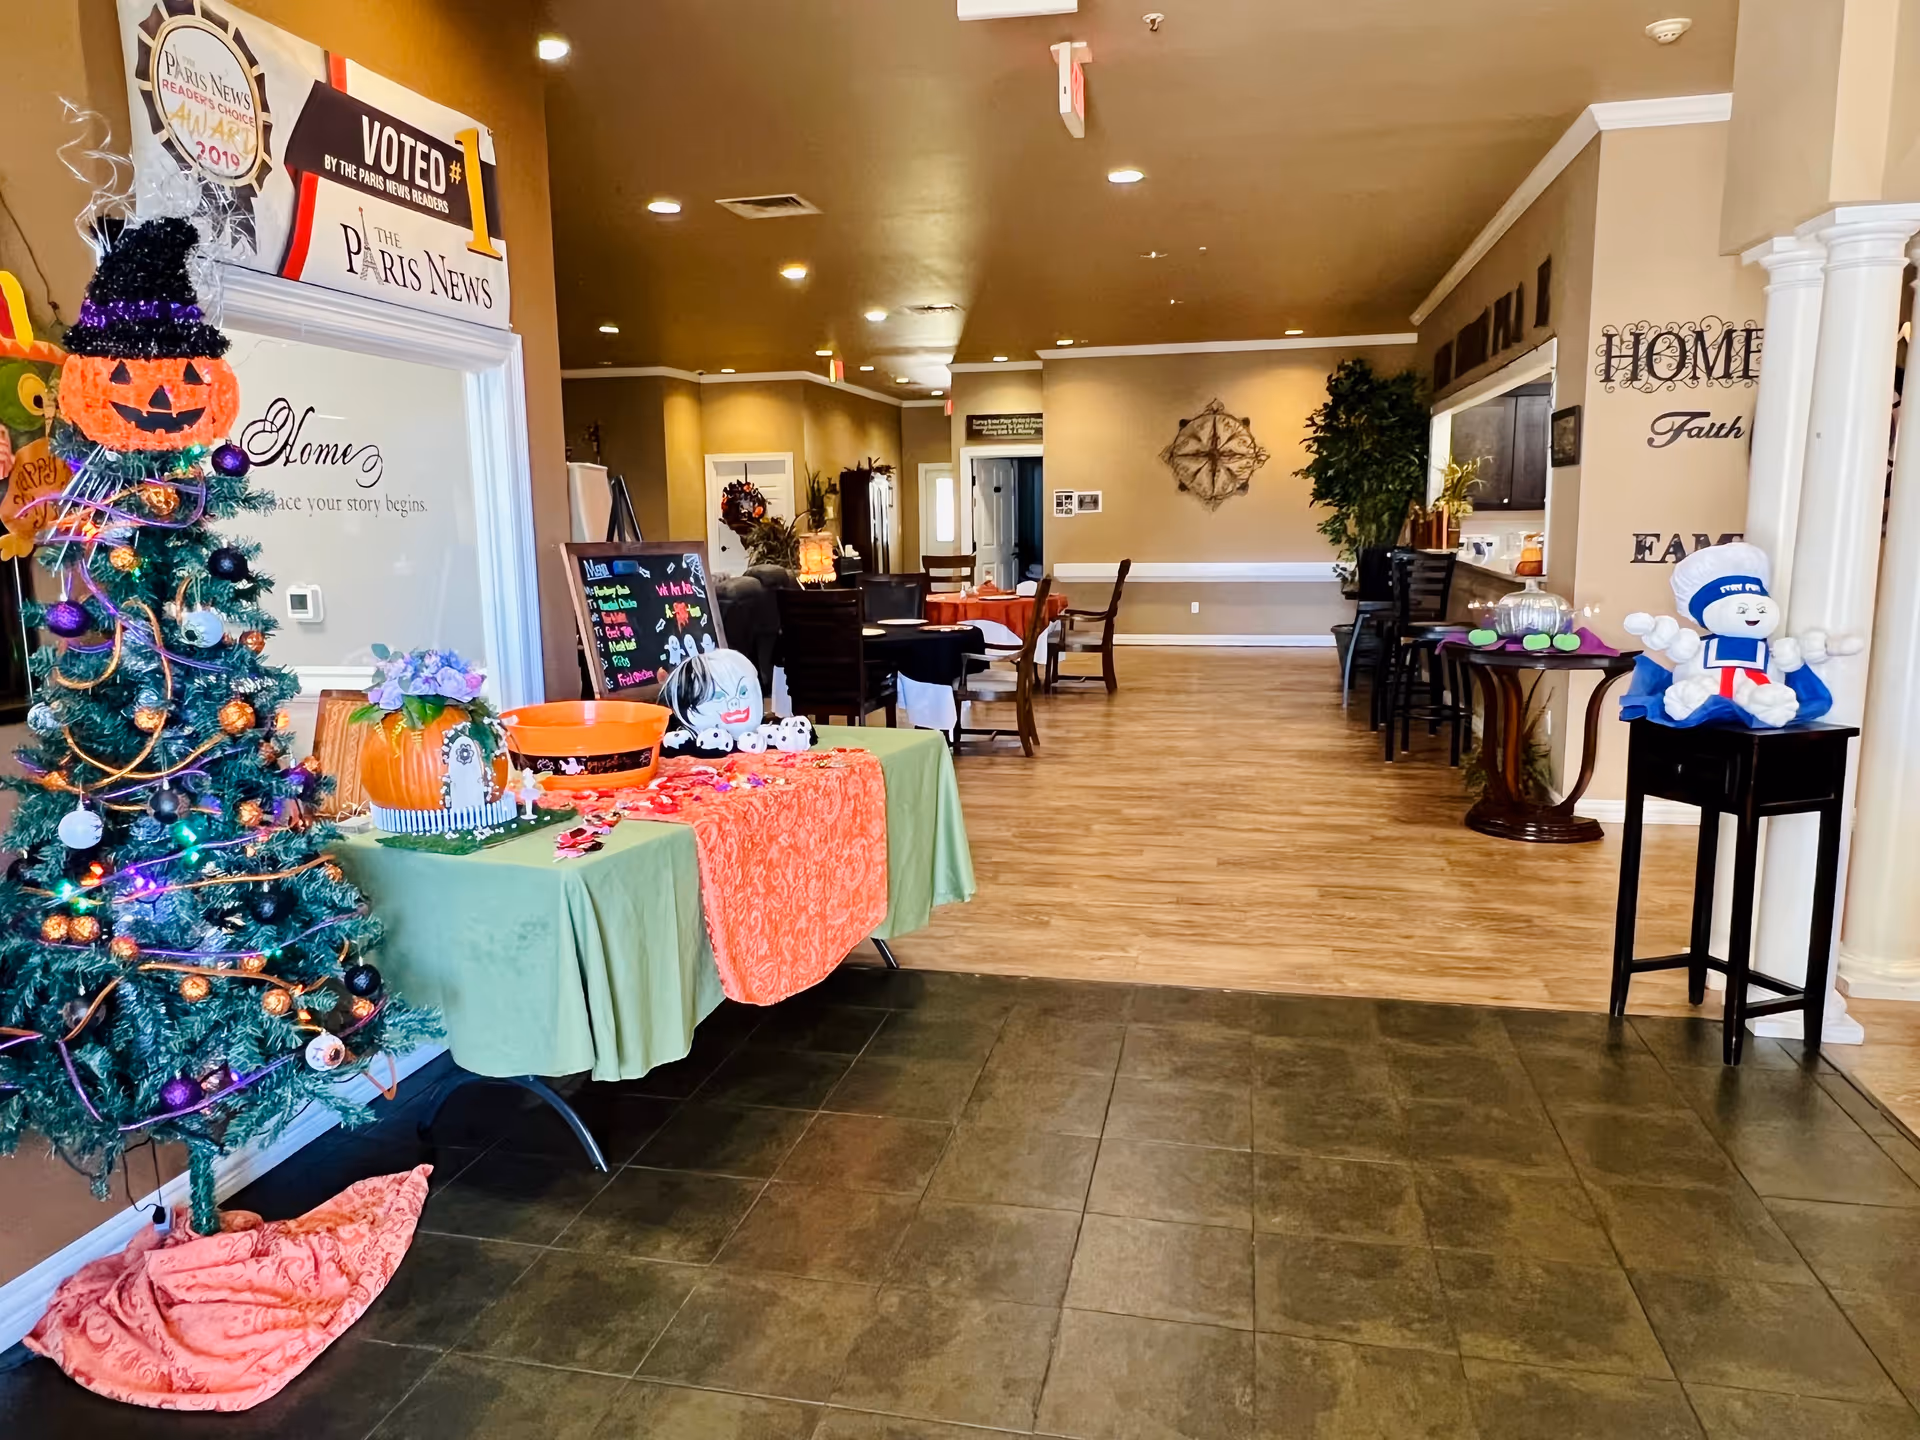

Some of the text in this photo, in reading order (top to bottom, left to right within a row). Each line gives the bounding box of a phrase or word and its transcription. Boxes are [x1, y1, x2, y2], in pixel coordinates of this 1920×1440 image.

[217, 103, 256, 128] CHOICE
[195, 139, 241, 171] 2019
[362, 115, 447, 194] VOTED
[324, 154, 450, 214] BY THE PARIS NEWS READERS
[339, 206, 493, 310] PARIS NEWS
[374, 226, 403, 250] THE
[1596, 322, 1764, 388] HOME
[240, 397, 383, 488] Home
[1646, 411, 1746, 449] Faith
[307, 497, 343, 517] your
[346, 495, 381, 517] story
[386, 493, 428, 518] begins.
